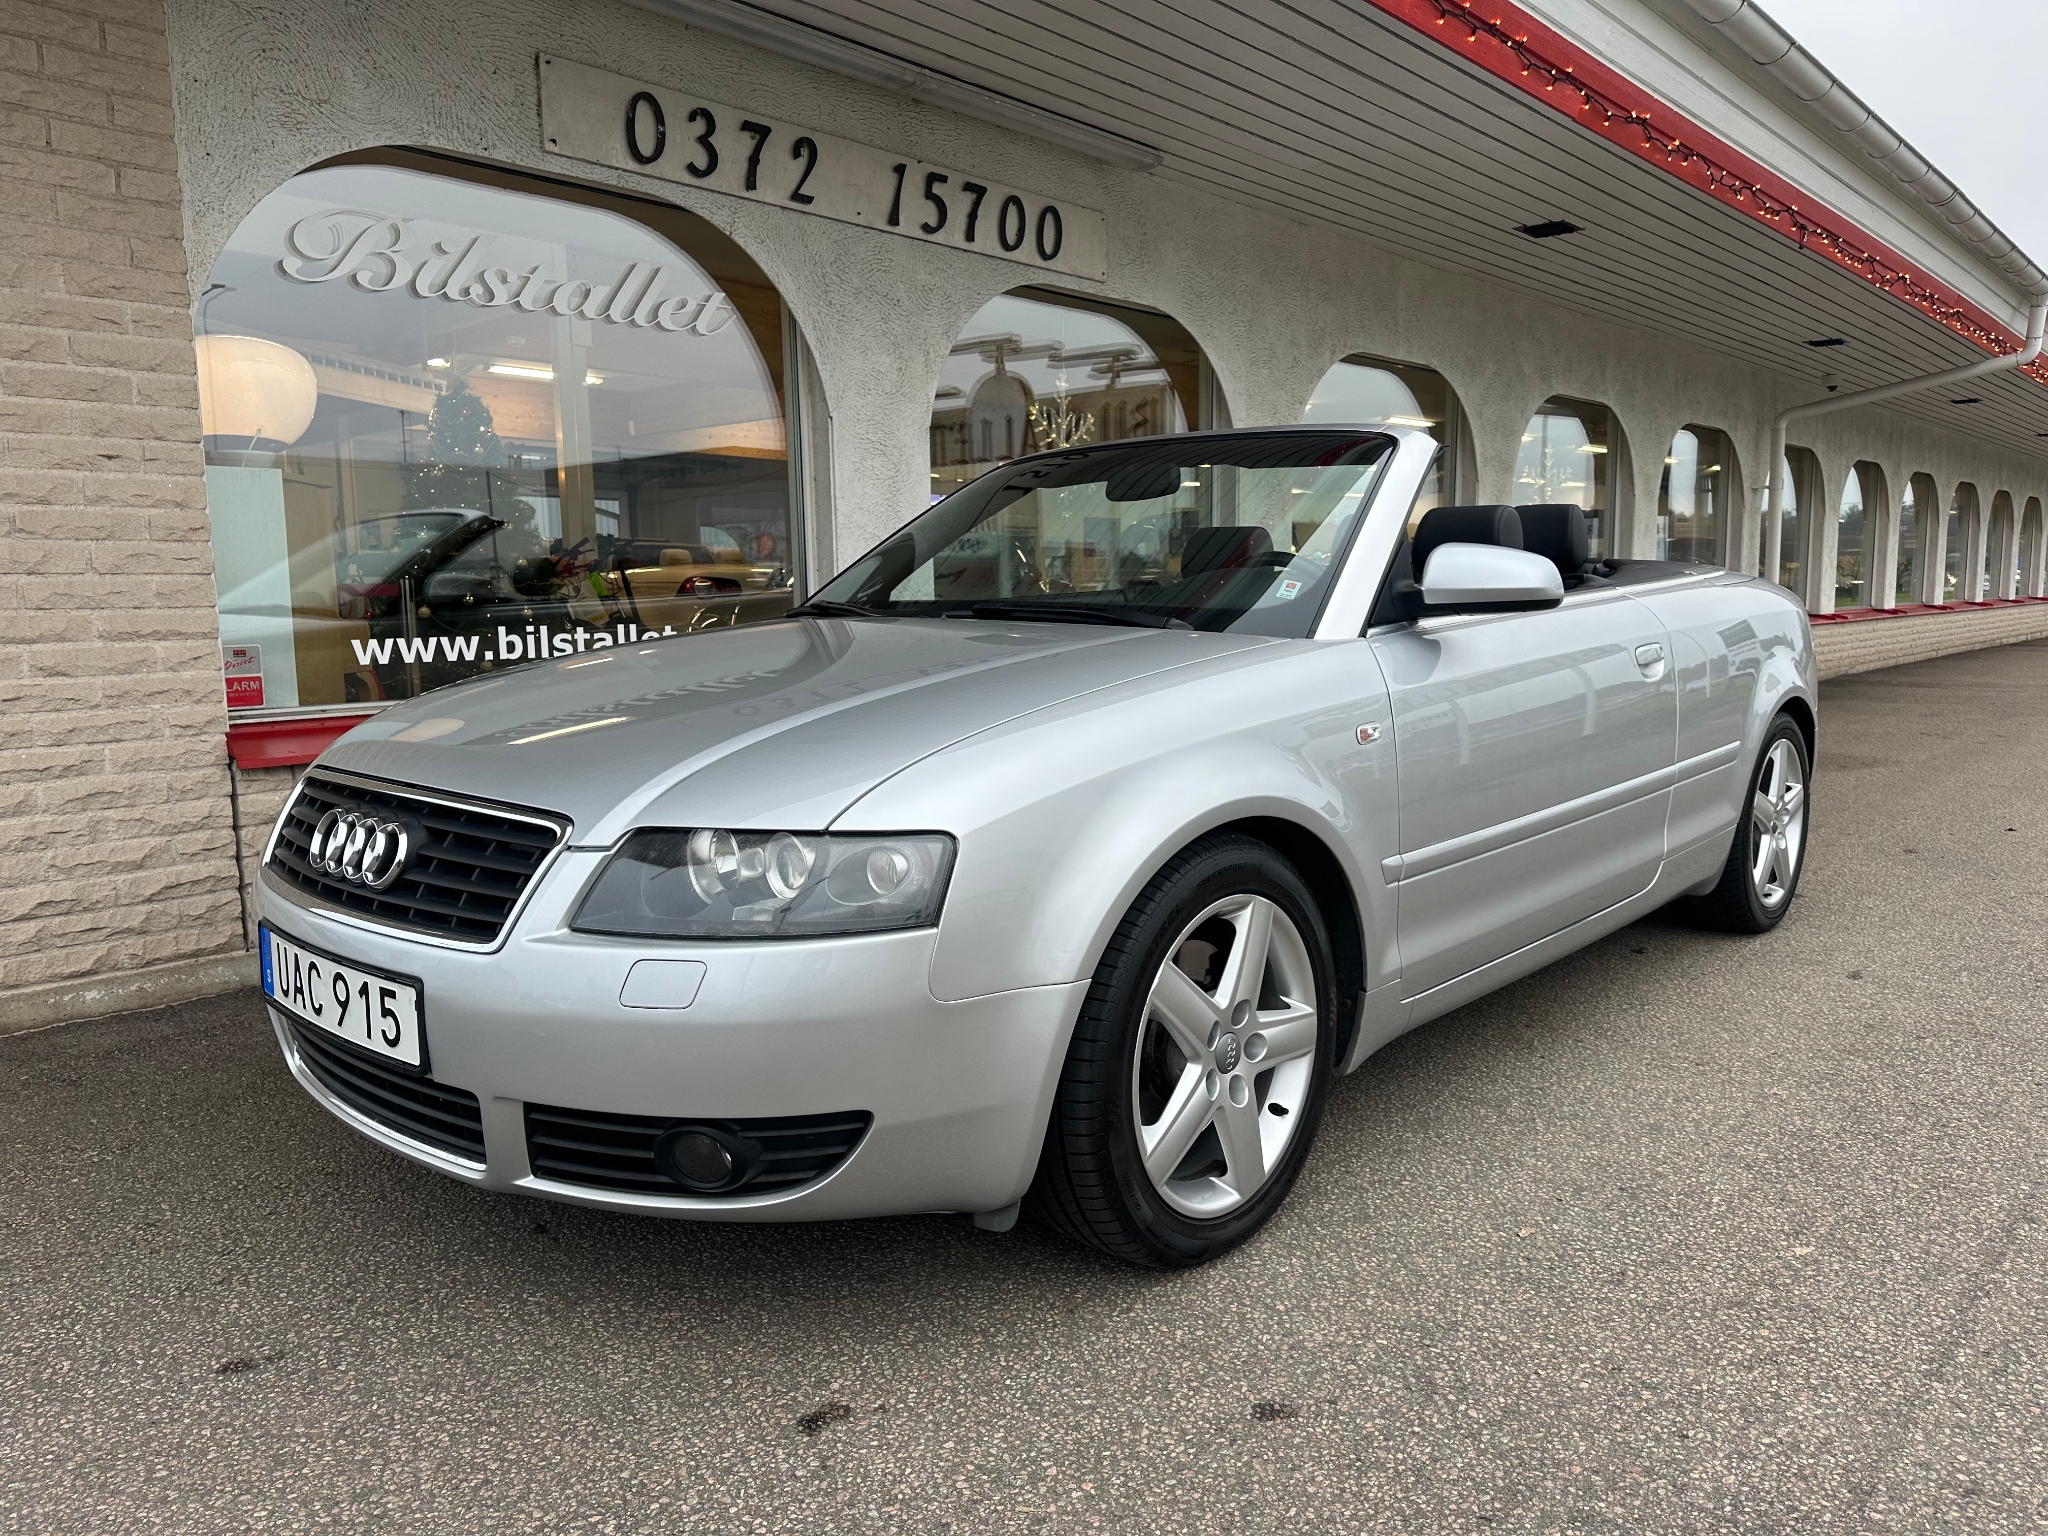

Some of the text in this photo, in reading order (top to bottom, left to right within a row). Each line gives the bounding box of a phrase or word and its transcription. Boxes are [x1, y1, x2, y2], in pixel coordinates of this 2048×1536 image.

[626, 91, 1063, 261] 0372 15700
[280, 208, 737, 336] Bilstallet
[1196, 861, 1248, 890] SUPERSPORT
[266, 968, 272, 983] S
[276, 941, 401, 1048] UAC 915
[1122, 1172, 1142, 1211] OUTSIDE
